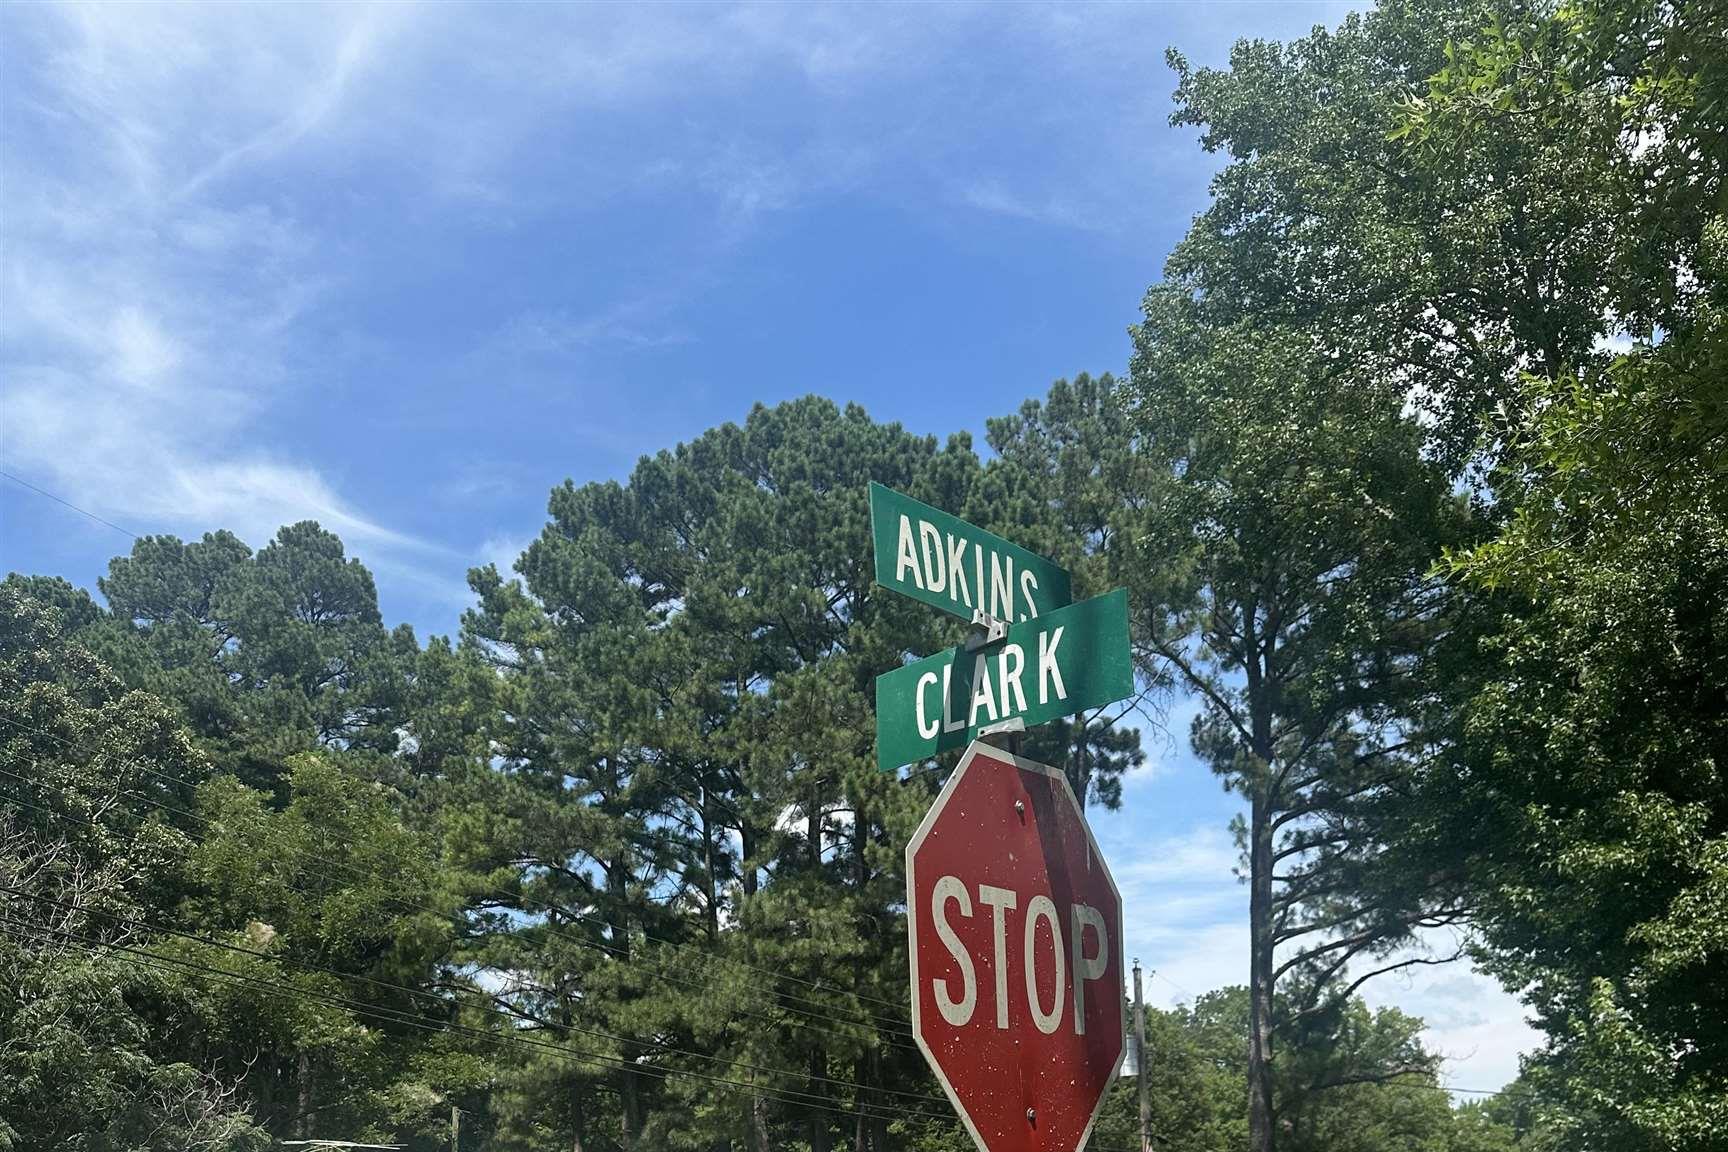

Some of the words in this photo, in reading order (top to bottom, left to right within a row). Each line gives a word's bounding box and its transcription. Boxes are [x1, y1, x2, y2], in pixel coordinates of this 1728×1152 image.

[896, 514, 1039, 623] ADKINS
[915, 626, 1067, 740] CLARK
[931, 875, 1109, 1036] STOP
